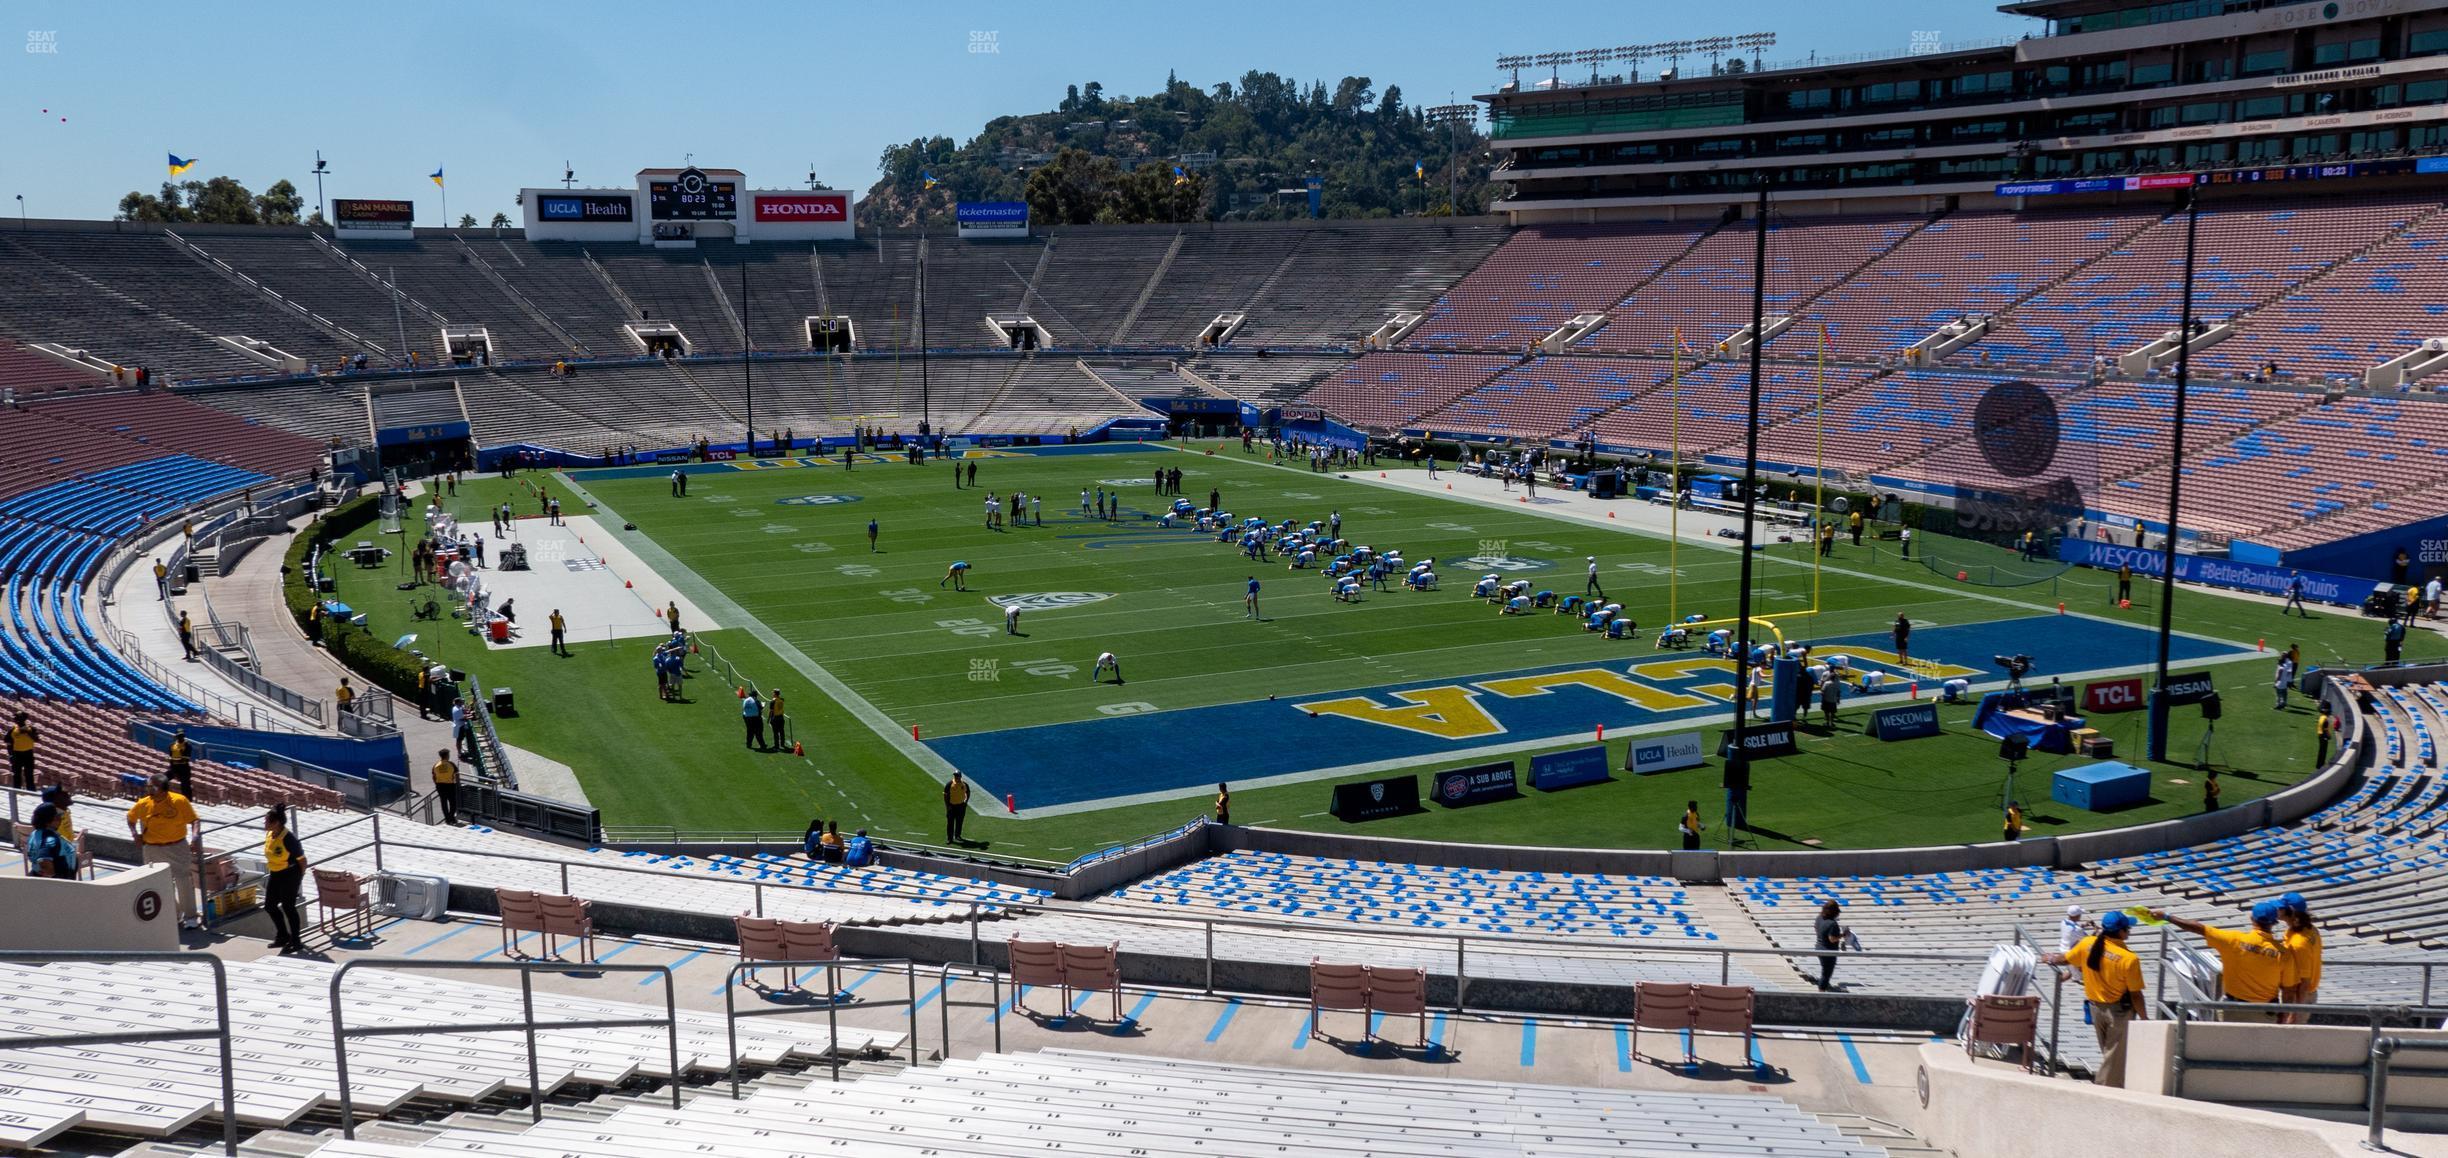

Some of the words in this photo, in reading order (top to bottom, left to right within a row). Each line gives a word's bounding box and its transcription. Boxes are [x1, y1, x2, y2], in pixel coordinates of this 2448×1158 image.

[2322, 166, 2346, 176] 80:23
[2002, 186, 2026, 194] TOYO
[2026, 184, 2053, 193] TIRES
[352, 203, 371, 211] SAN
[373, 204, 408, 212] MANUEL
[550, 204, 578, 214] UCLA
[586, 203, 626, 216] Health
[762, 204, 840, 214] HONDA
[960, 208, 1022, 216] ticketmaster
[1282, 410, 1319, 419] HONDA
[710, 452, 732, 460] TCL
[2088, 544, 2167, 575] WESCOM
[878, 588, 934, 602] 30
[934, 618, 1000, 636] 20
[1009, 658, 1079, 676] 10
[2095, 685, 2136, 704] TCL
[1095, 702, 1159, 715] G
[1881, 712, 1923, 726] WESCOM
[1767, 732, 1789, 746] MILK
[1639, 750, 1661, 761] UCLA
[1667, 744, 1698, 758] Health
[1470, 776, 1475, 785] A
[1477, 774, 1489, 784] SUB
[1492, 770, 1512, 782] ABOVE
[143, 897, 154, 915] 9
[65, 1097, 94, 1105] 117
